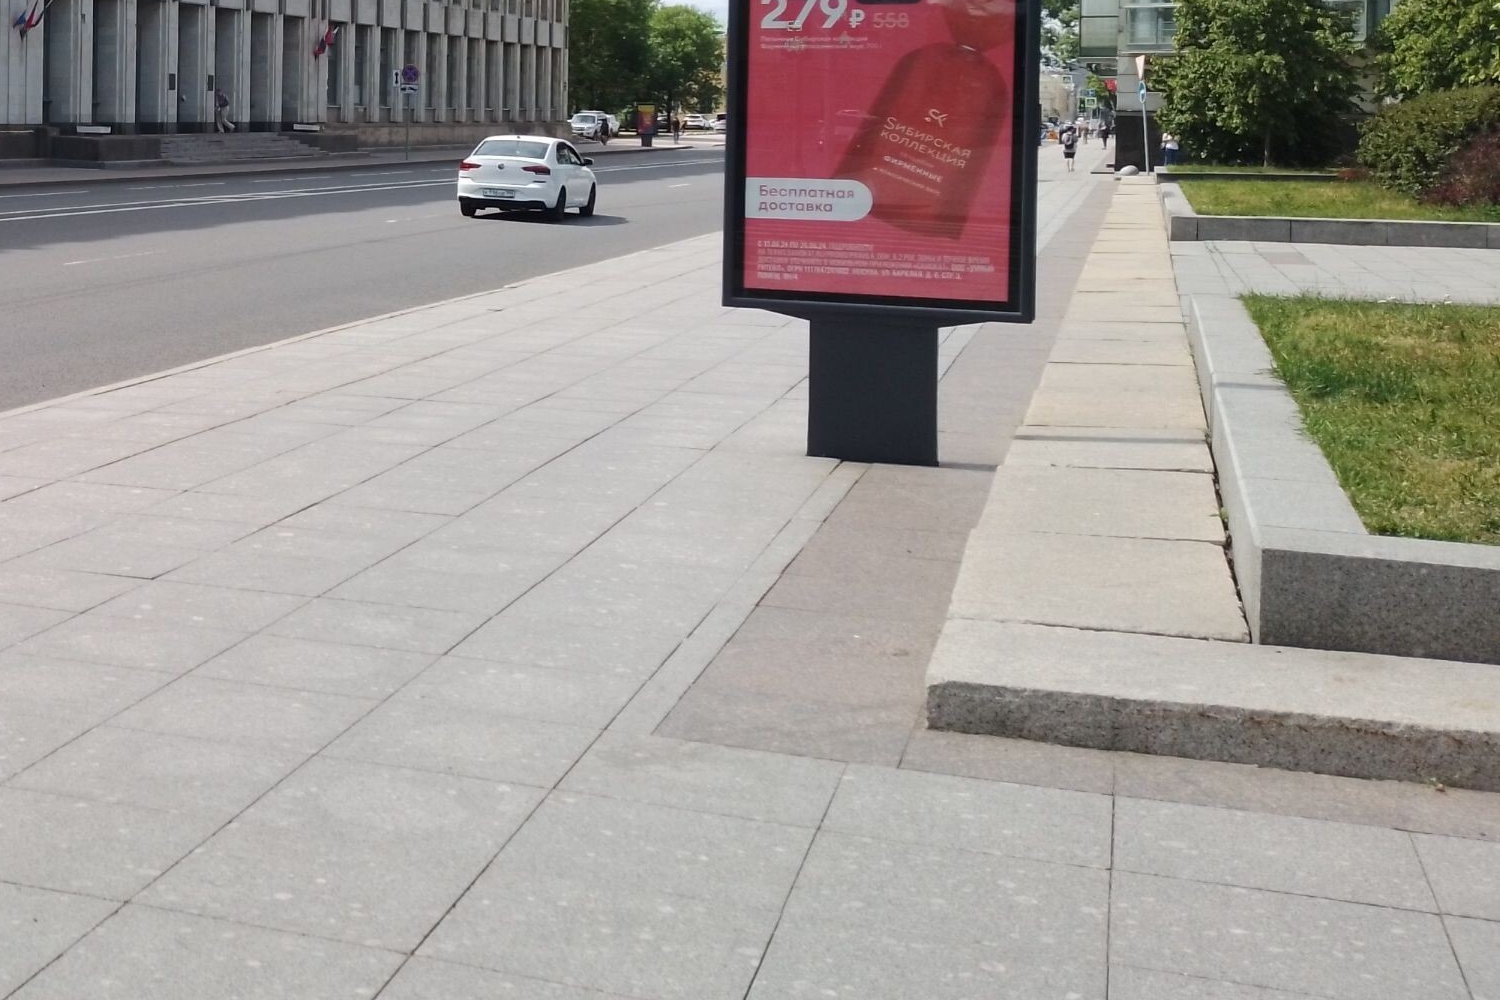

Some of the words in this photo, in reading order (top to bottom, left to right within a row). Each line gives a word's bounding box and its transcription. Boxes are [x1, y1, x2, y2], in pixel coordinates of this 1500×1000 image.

[880, 129, 966, 168] КОЛЛЕКЦИЯ
[759, 184, 855, 199] Бесплатная
[758, 201, 833, 213] доставка
